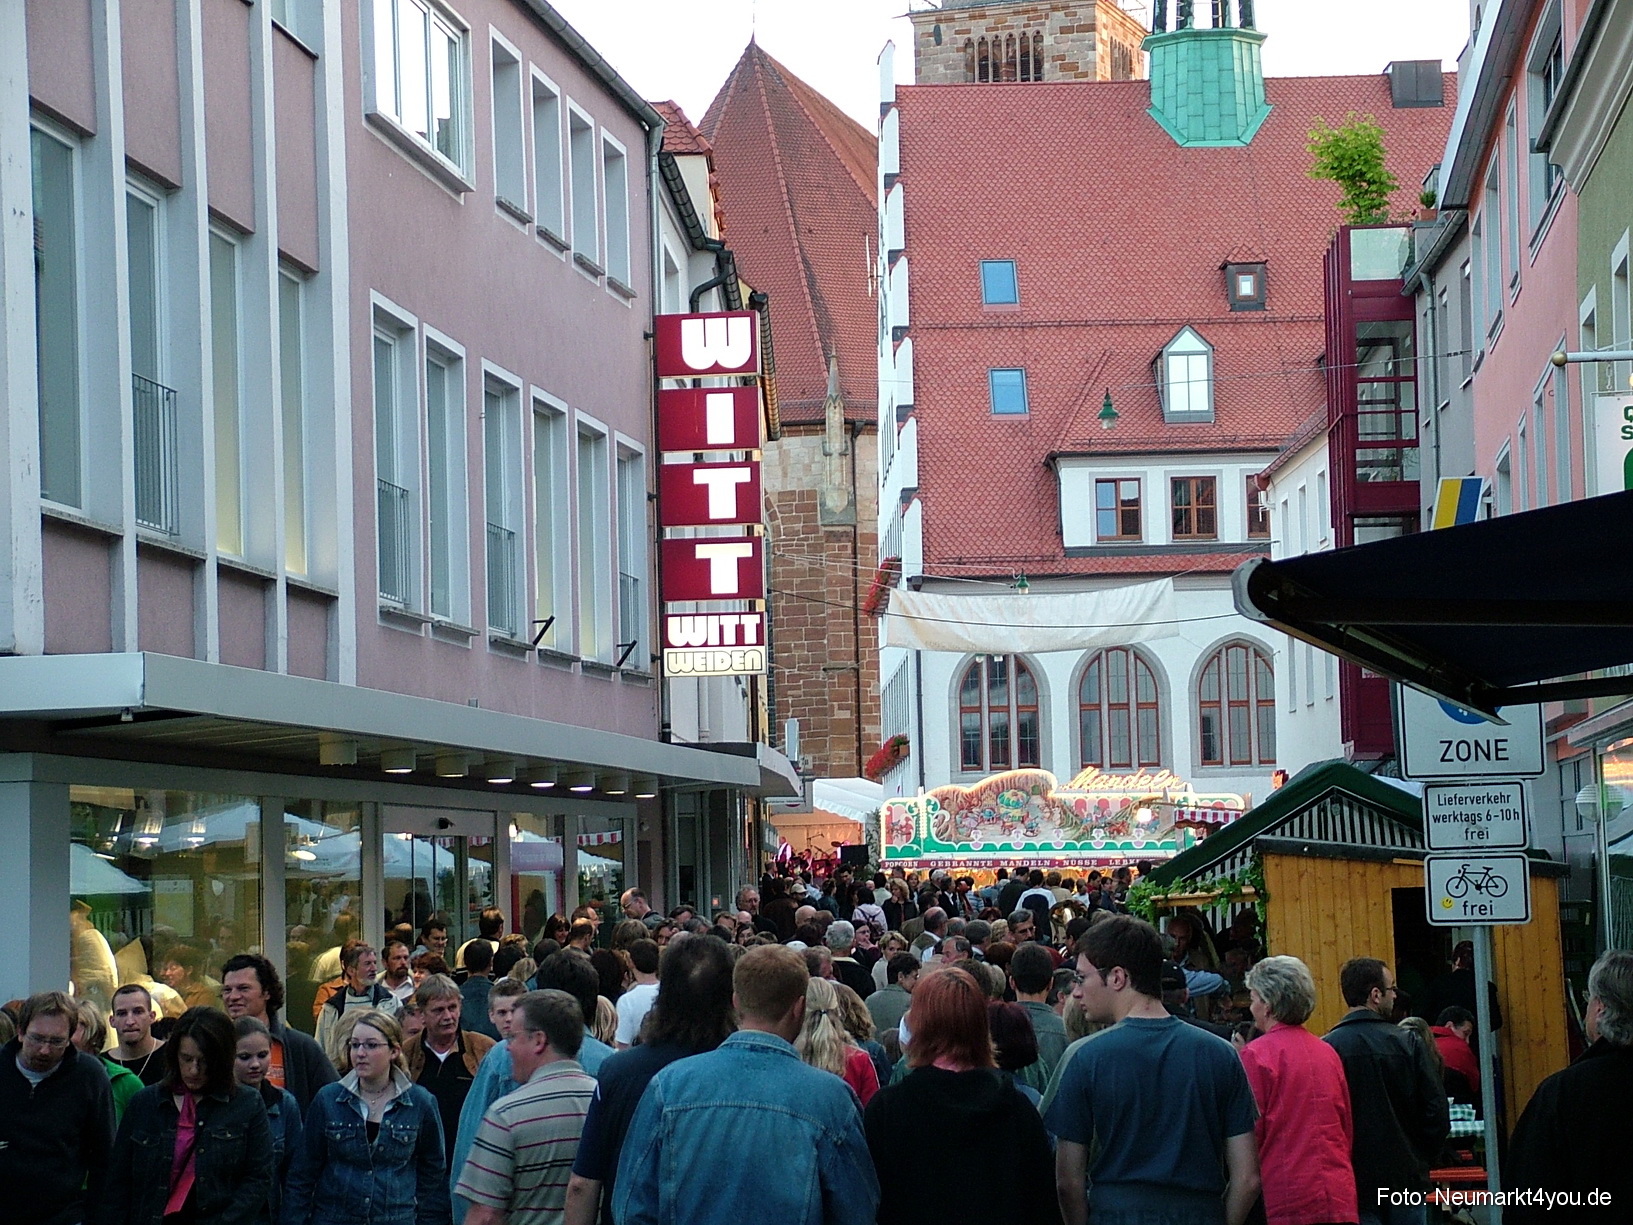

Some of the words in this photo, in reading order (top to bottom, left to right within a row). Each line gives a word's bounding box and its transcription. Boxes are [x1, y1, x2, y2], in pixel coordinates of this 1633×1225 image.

[667, 614, 760, 646] WITT
[666, 649, 762, 673] WEIDEN
[1440, 739, 1509, 763] ZONE
[1060, 766, 1184, 790] Mandeln
[1437, 792, 1511, 806] Lieferverkehr
[1432, 810, 1483, 825] werktags
[1464, 827, 1489, 840] frei
[1462, 901, 1494, 915] frei
